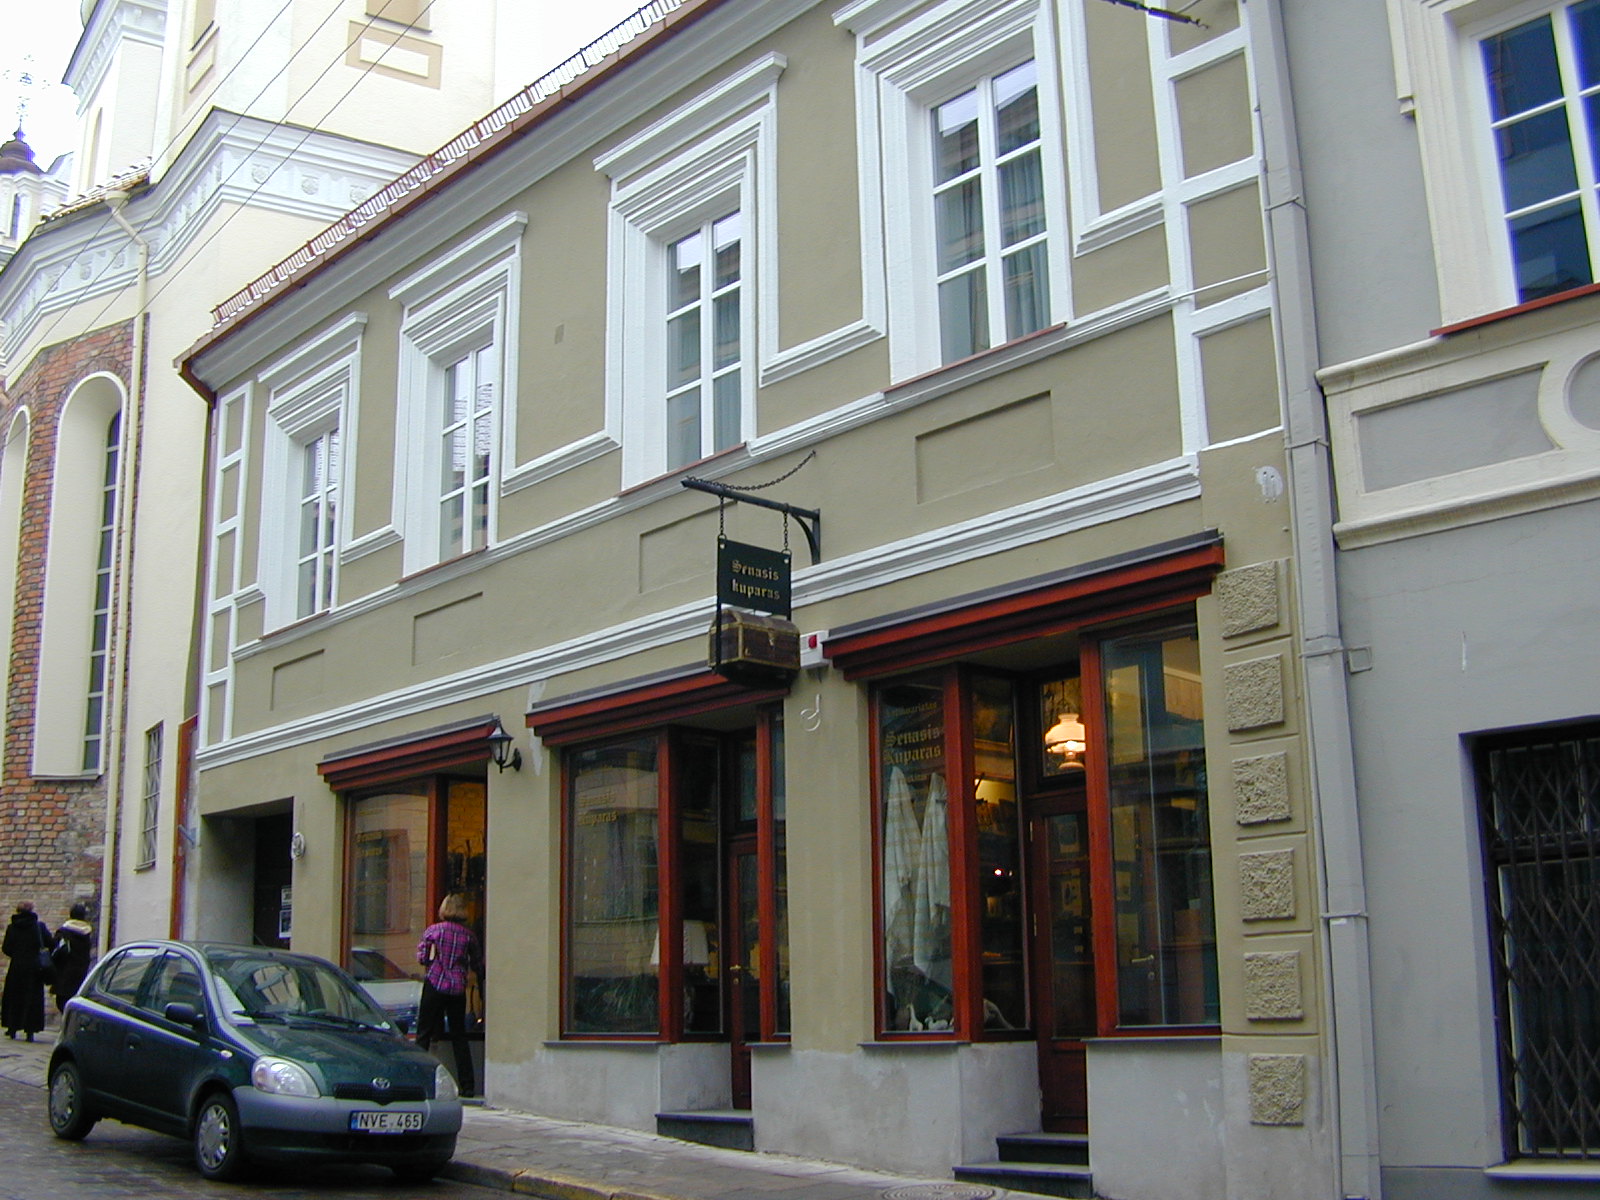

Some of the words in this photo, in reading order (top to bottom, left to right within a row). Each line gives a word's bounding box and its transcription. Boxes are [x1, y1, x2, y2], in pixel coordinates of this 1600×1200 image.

[731, 559, 780, 581] Senasis
[885, 724, 940, 747] Senasis
[359, 1113, 388, 1128] NVE
[397, 1114, 420, 1128] 465
